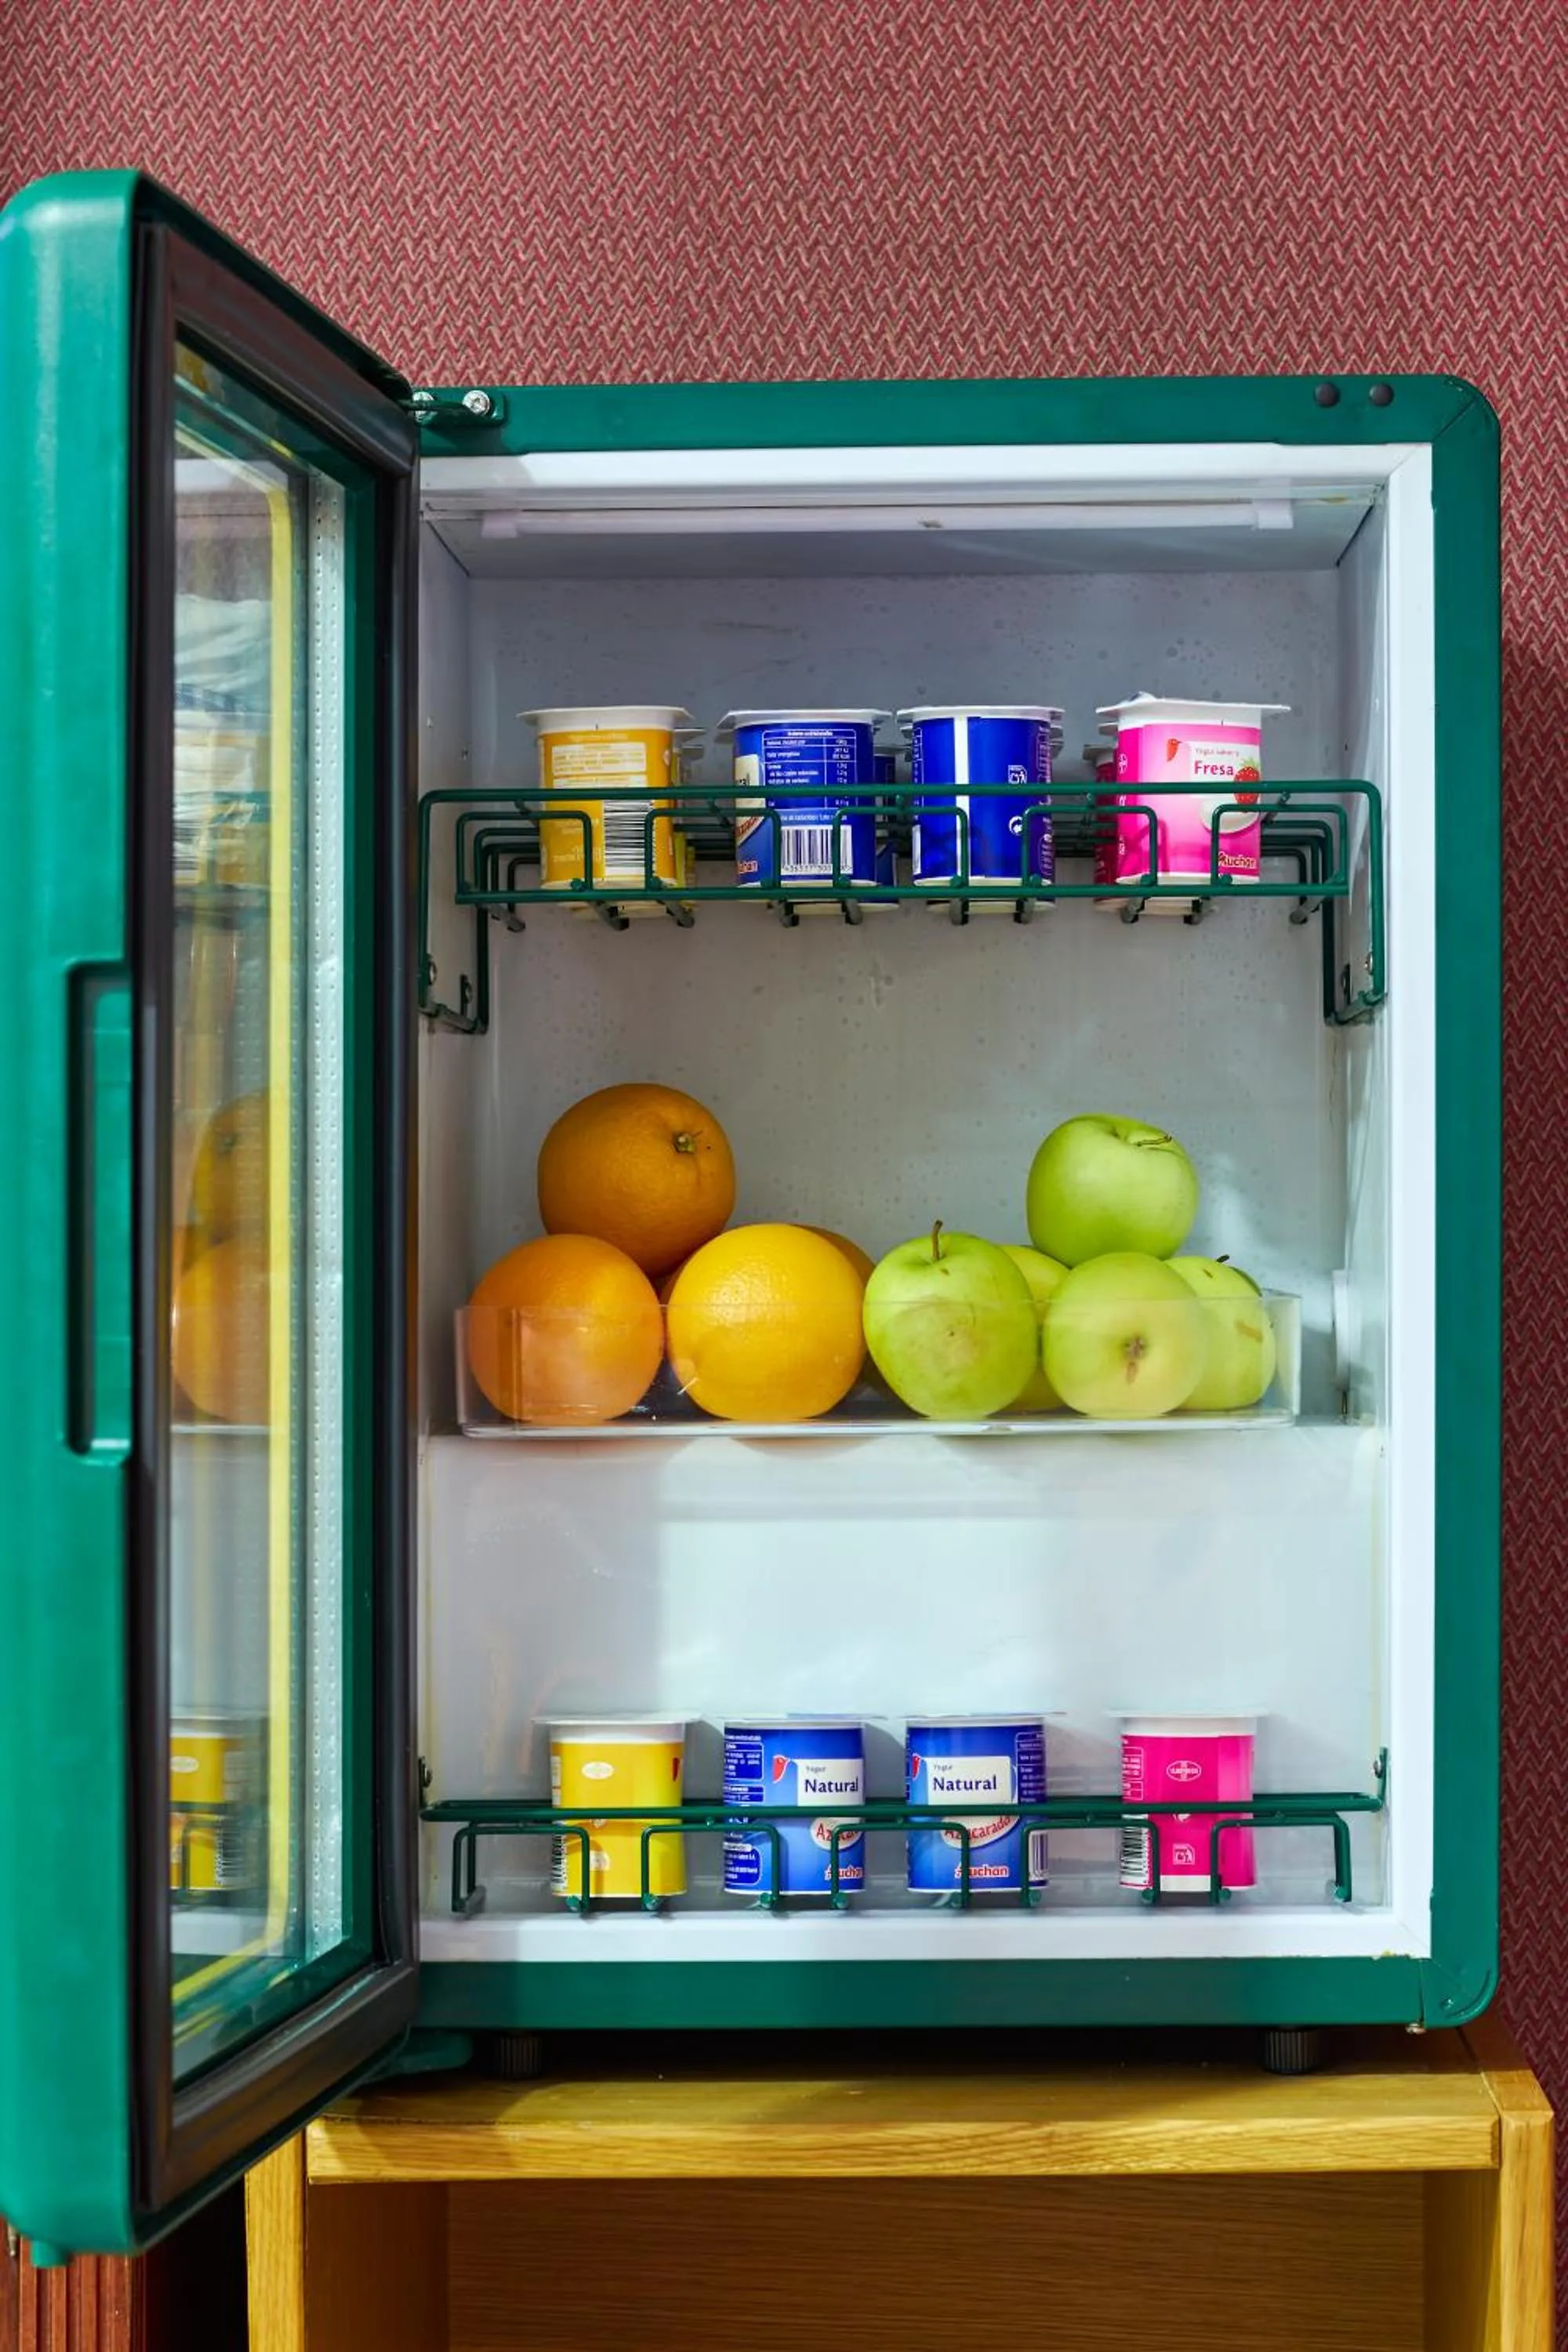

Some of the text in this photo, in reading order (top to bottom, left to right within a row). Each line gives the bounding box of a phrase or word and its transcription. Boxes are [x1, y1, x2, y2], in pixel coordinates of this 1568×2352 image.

[1194, 760, 1234, 775] Fresa
[804, 1775, 858, 1792] Natural
[933, 1773, 996, 1791] Natural
